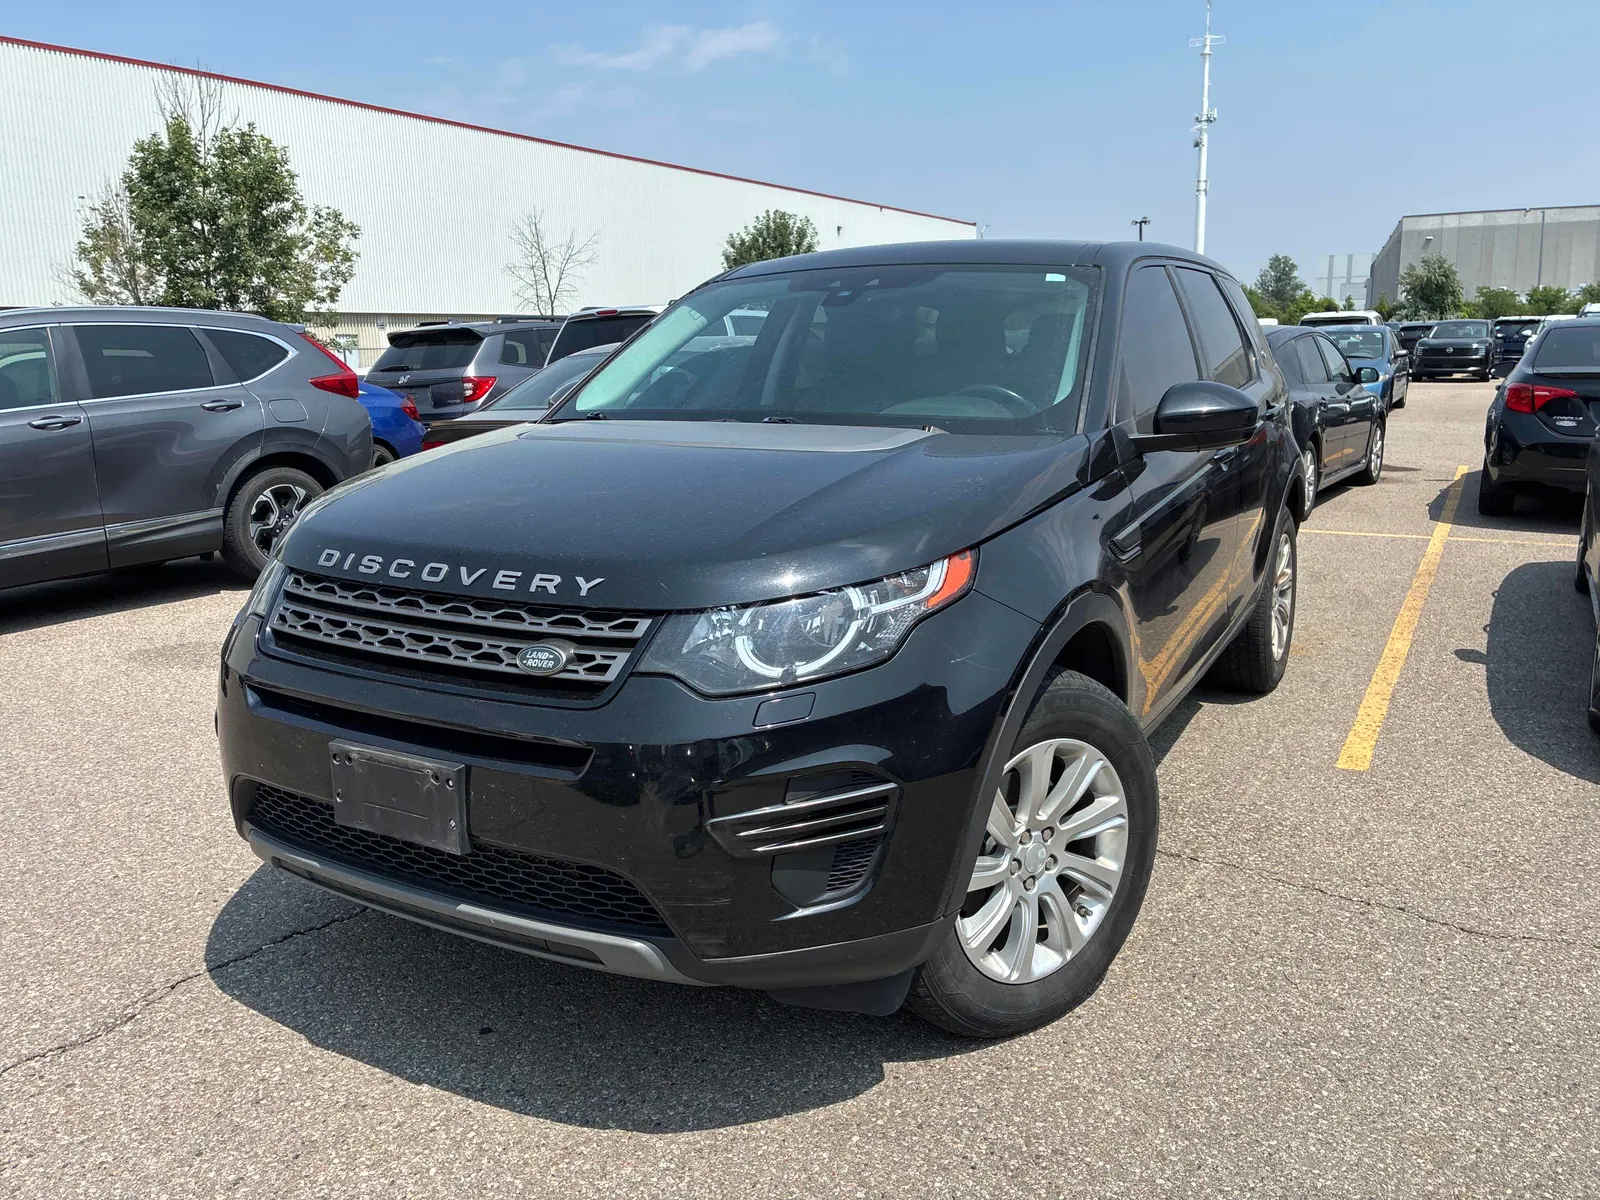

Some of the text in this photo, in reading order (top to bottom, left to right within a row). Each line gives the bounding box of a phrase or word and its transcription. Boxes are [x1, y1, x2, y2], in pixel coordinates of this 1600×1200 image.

[318, 549, 605, 597] DISCOVERY
[526, 651, 549, 660] LAND
[526, 659, 554, 668] ROVER
